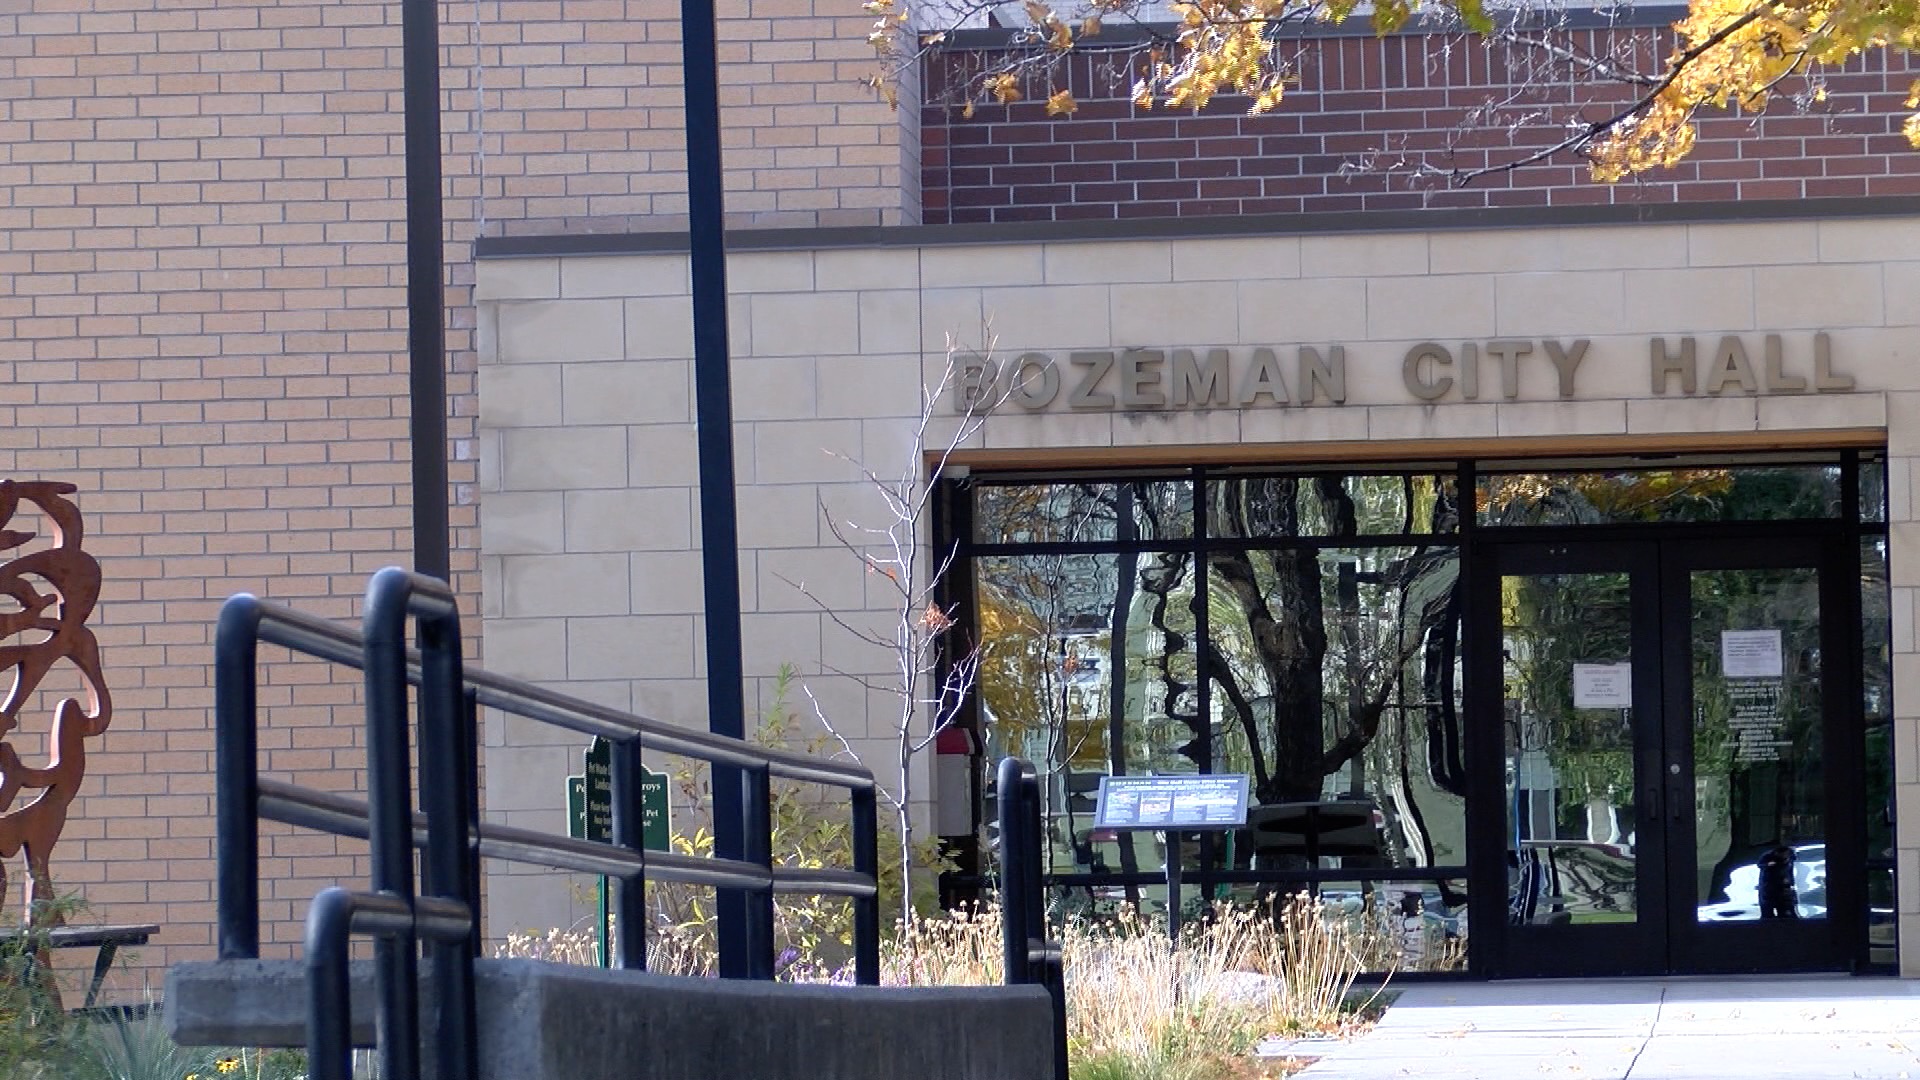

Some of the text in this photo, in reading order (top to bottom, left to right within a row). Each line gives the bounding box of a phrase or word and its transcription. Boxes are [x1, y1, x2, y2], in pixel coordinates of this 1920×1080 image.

[953, 332, 1856, 412] BOZEMAN CITY HALL
